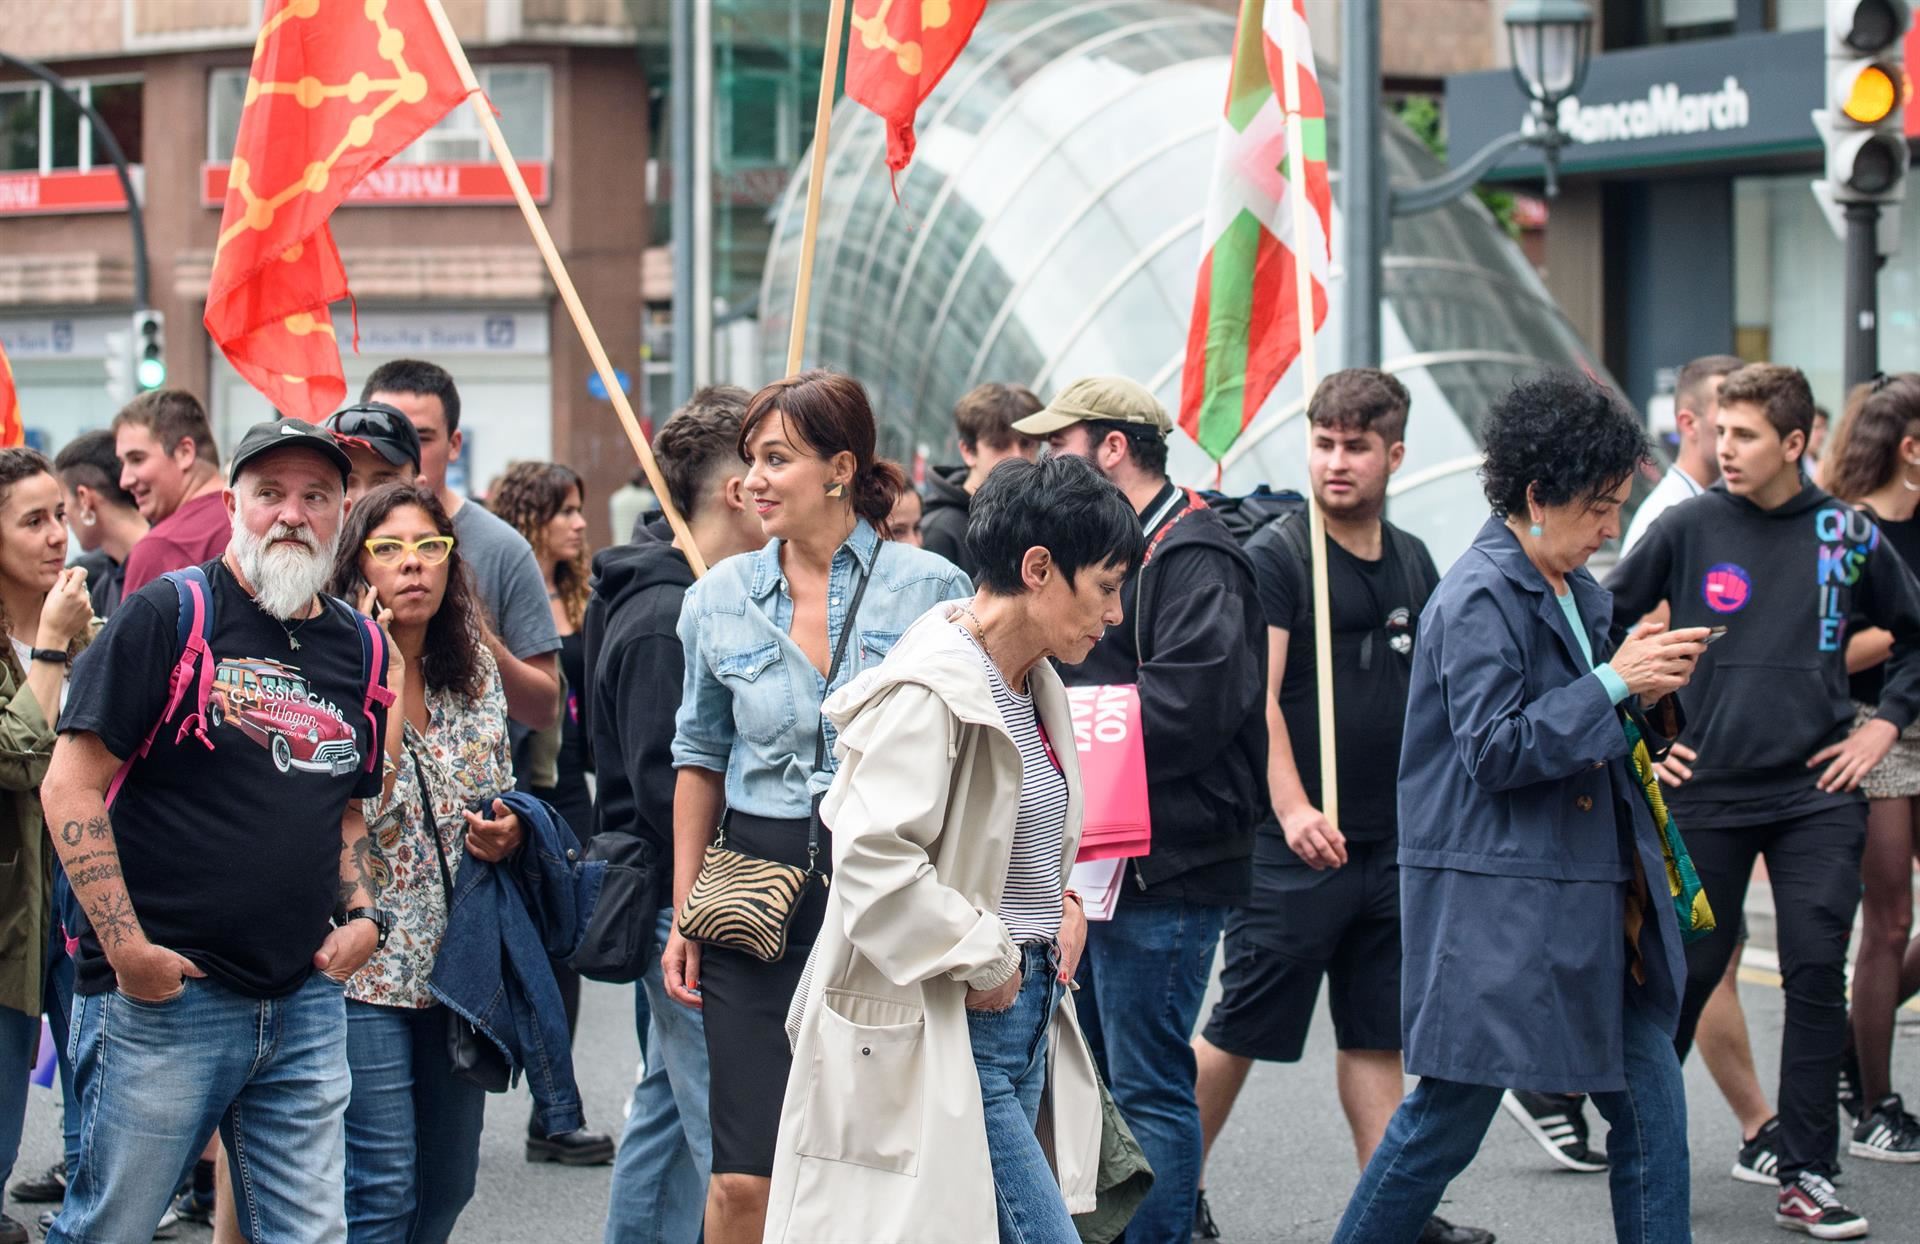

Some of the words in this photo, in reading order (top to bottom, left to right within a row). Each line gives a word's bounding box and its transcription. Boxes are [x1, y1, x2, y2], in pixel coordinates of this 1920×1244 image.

[230, 684, 302, 704] CLASSIC
[306, 692, 344, 723] CARS
[264, 701, 319, 730] Wagon
